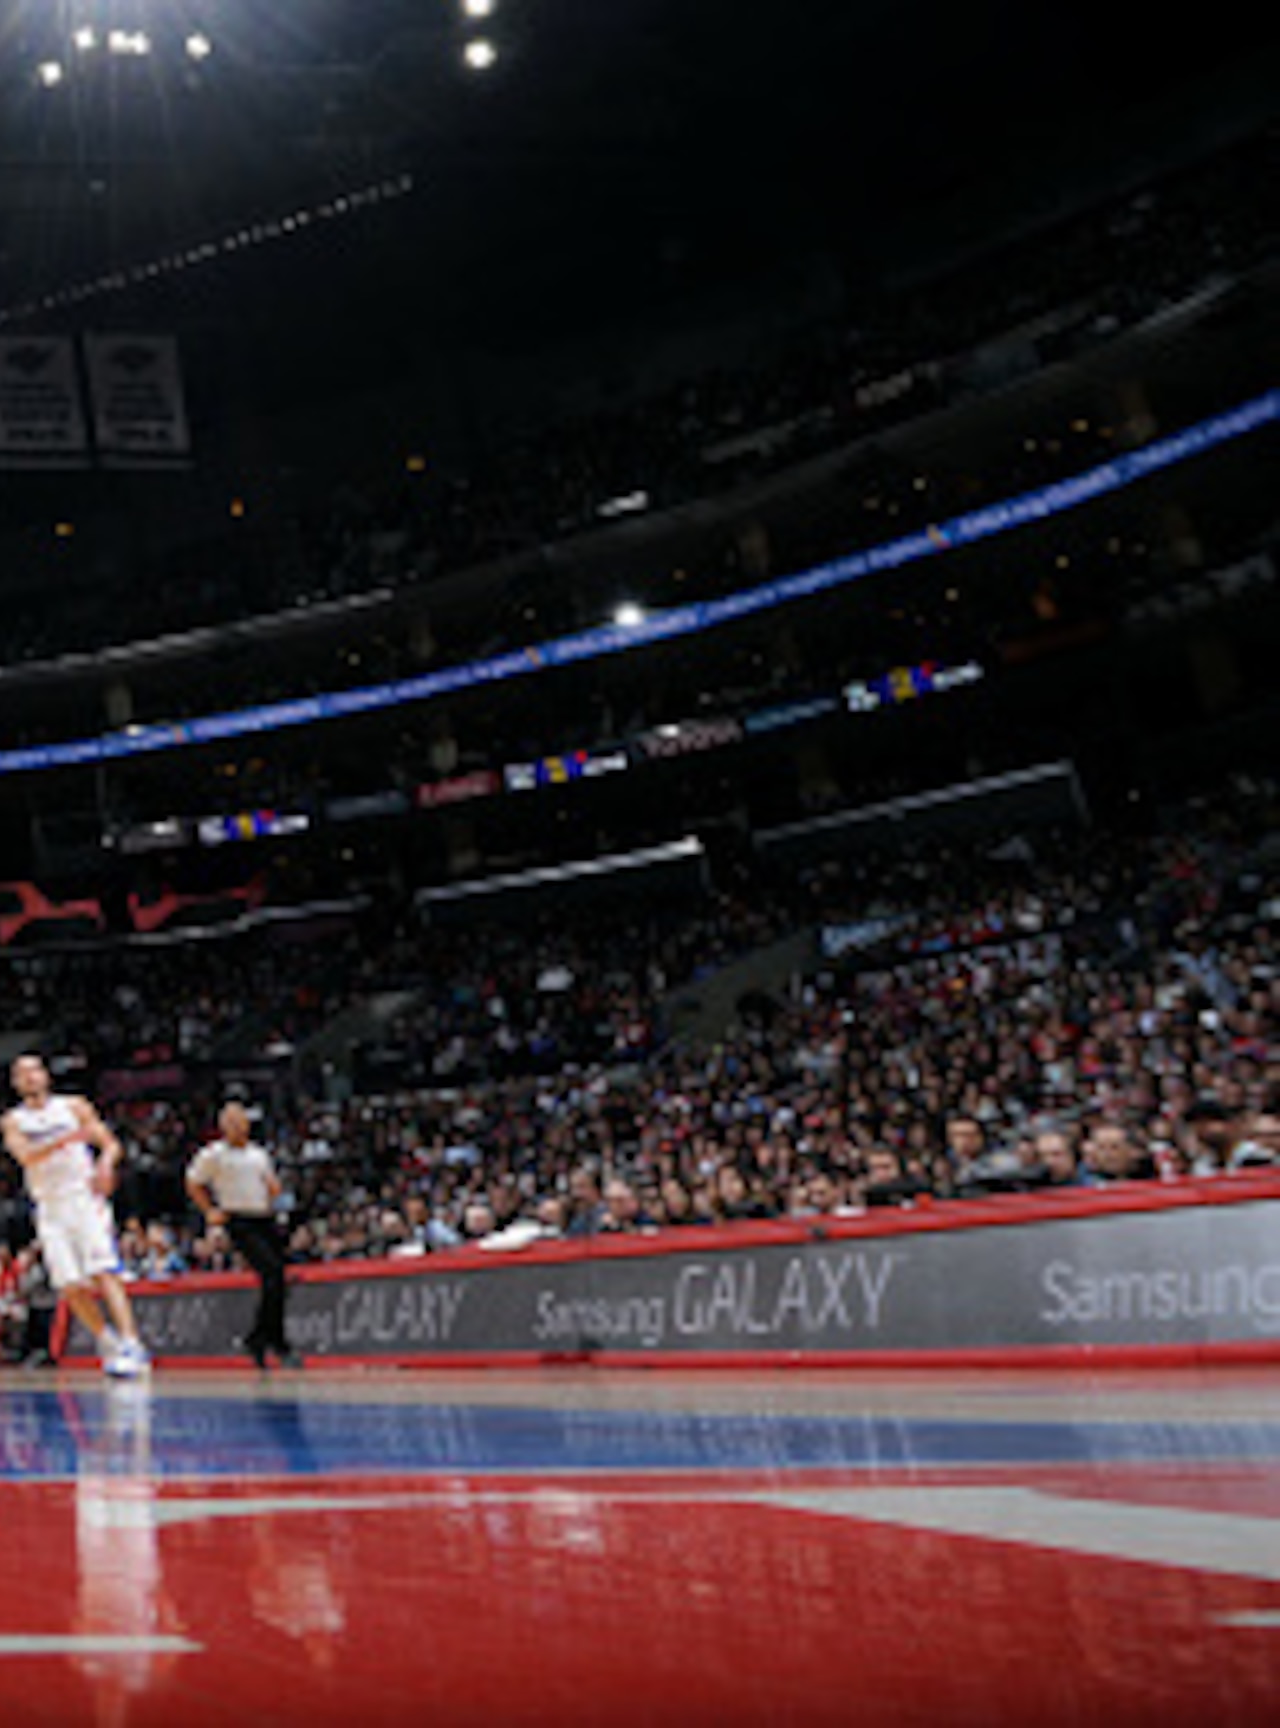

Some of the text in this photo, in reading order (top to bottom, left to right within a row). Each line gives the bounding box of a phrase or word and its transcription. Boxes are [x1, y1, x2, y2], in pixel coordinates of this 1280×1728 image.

[335, 1283, 464, 1343] GALAXY
[533, 1252, 893, 1346] Samsung GALAXY
